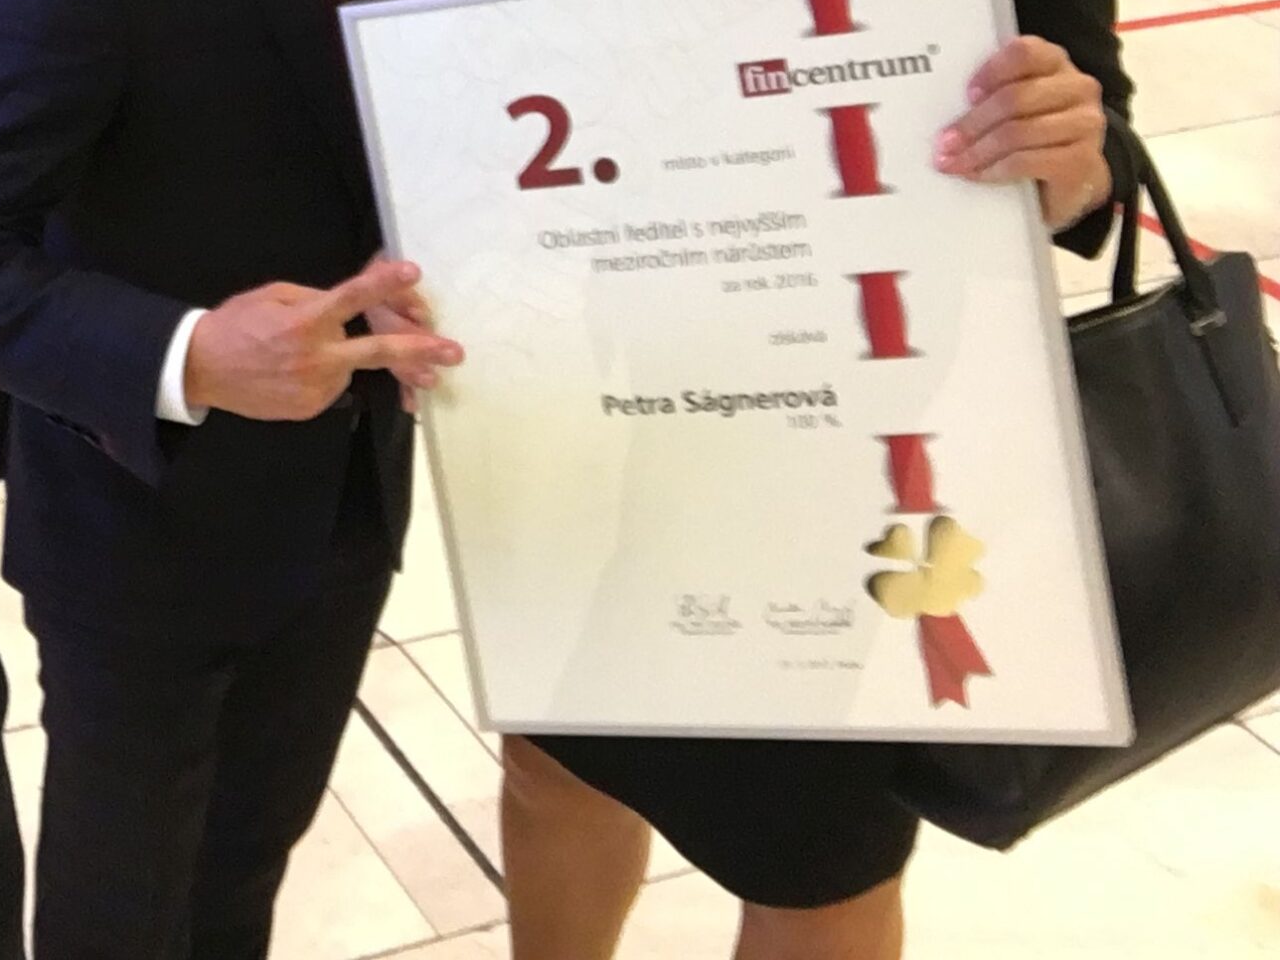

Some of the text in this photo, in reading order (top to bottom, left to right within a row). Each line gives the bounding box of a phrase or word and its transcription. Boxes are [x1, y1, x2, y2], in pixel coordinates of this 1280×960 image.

[505, 94, 620, 190] 2.
[601, 381, 838, 417] Petra Ságnerová
